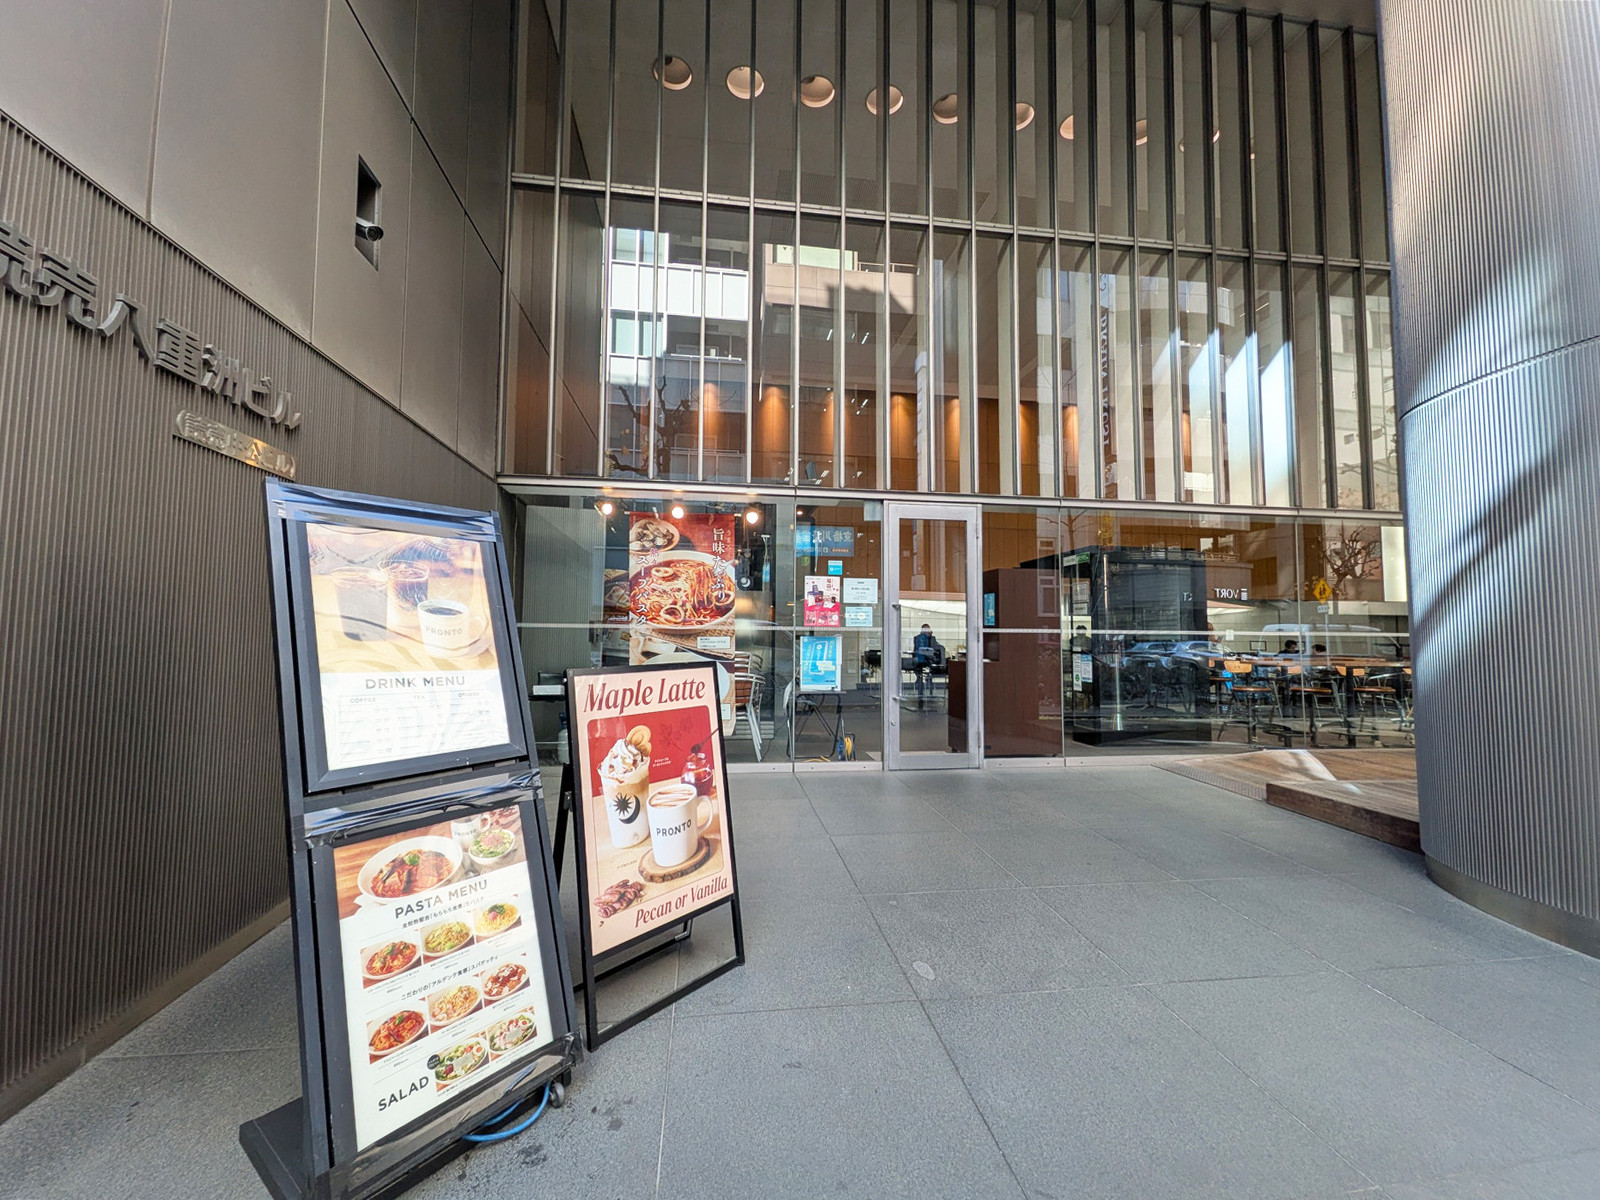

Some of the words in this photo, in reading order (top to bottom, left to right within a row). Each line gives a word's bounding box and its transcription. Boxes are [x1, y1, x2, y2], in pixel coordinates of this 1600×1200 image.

[712, 527, 727, 602] 旨味たっぷり
[636, 555, 649, 626] スープパスタ
[425, 626, 463, 637] PRONTO
[365, 677, 417, 690] DRINK
[423, 675, 466, 688] MENU
[584, 678, 653, 716] Maple
[658, 677, 706, 705] Latte
[656, 818, 692, 837] PRONTO
[395, 895, 443, 919] PASTA
[448, 880, 488, 902] MENU
[634, 904, 673, 928] Pecan
[675, 892, 688, 909] or
[691, 875, 728, 902] Vanilla
[378, 1075, 430, 1112] SALAD
